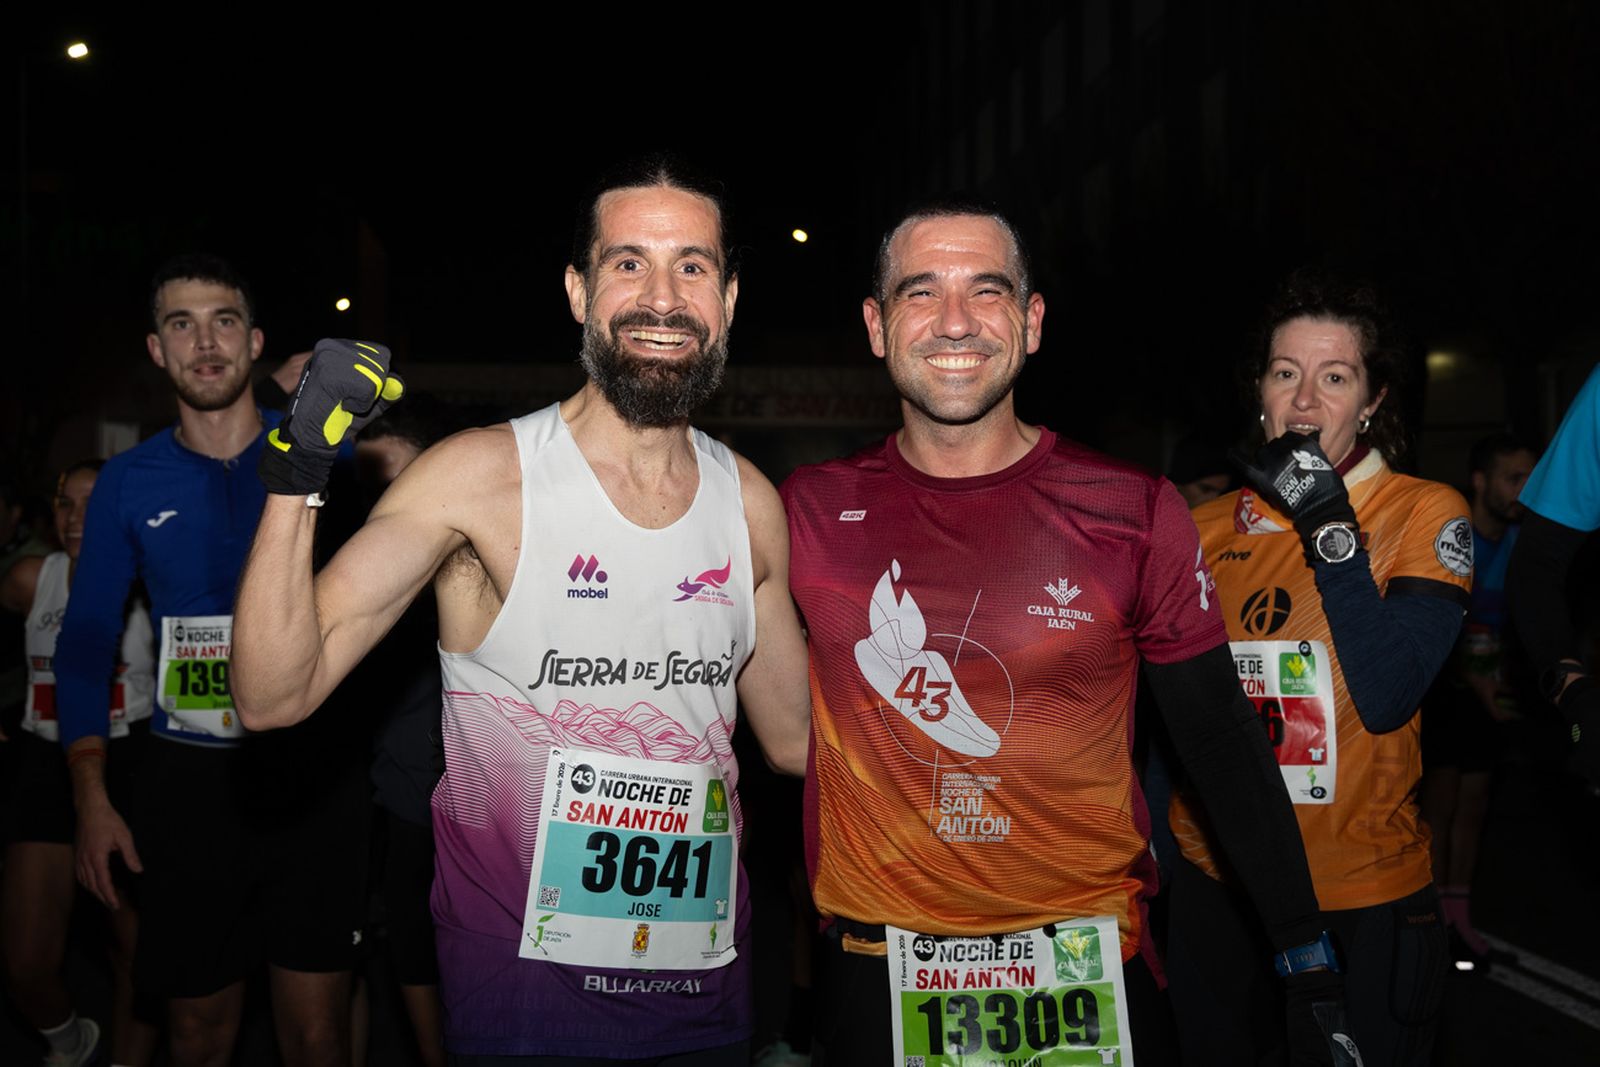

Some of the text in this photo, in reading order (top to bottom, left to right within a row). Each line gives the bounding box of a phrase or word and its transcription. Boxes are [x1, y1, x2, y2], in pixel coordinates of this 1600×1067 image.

[1280, 476, 1299, 500] SAN
[567, 587, 609, 599] mobel
[1027, 605, 1095, 622] CAJA RURAL
[187, 630, 224, 642] NOCHE
[176, 645, 198, 659] SAN
[528, 649, 734, 691] SIERRA DE SEGURA
[1248, 659, 1263, 674] DE
[894, 666, 951, 723] 43
[572, 770, 595, 787] 43
[600, 769, 693, 788] CARRERA URBANA INTERNACIONAL
[597, 778, 693, 807] NOCHE DE
[941, 788, 984, 797] NOCHE DE
[938, 796, 983, 815] SAN
[566, 800, 689, 834] SAN ANTÓN
[936, 811, 1011, 835] ANTÓN
[582, 831, 713, 899] 3641
[627, 902, 662, 917] JOSE
[913, 940, 935, 954] 43
[940, 941, 1034, 963] NOCHE DE
[915, 968, 958, 990] SAN
[963, 961, 1036, 989] ANTÓN
[917, 988, 1100, 1056] 13309
